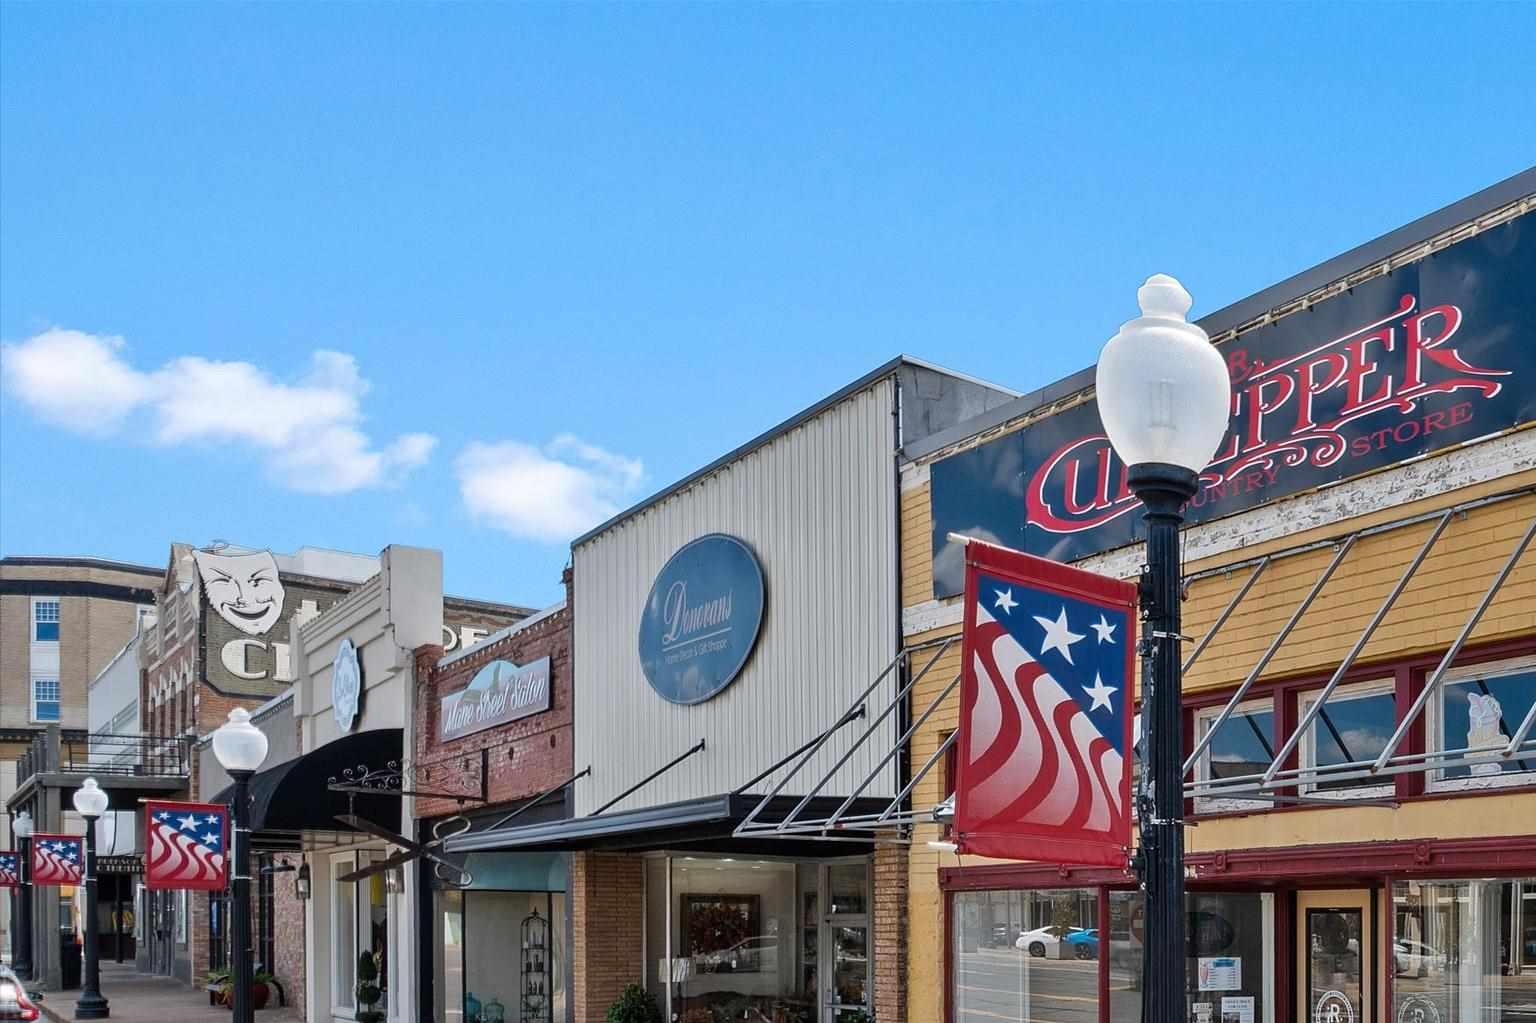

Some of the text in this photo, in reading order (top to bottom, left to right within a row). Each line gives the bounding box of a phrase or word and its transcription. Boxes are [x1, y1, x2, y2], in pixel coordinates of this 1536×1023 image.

[1026, 294, 1512, 533] CUPPER
[1180, 401, 1473, 513] UNTRY STORE
